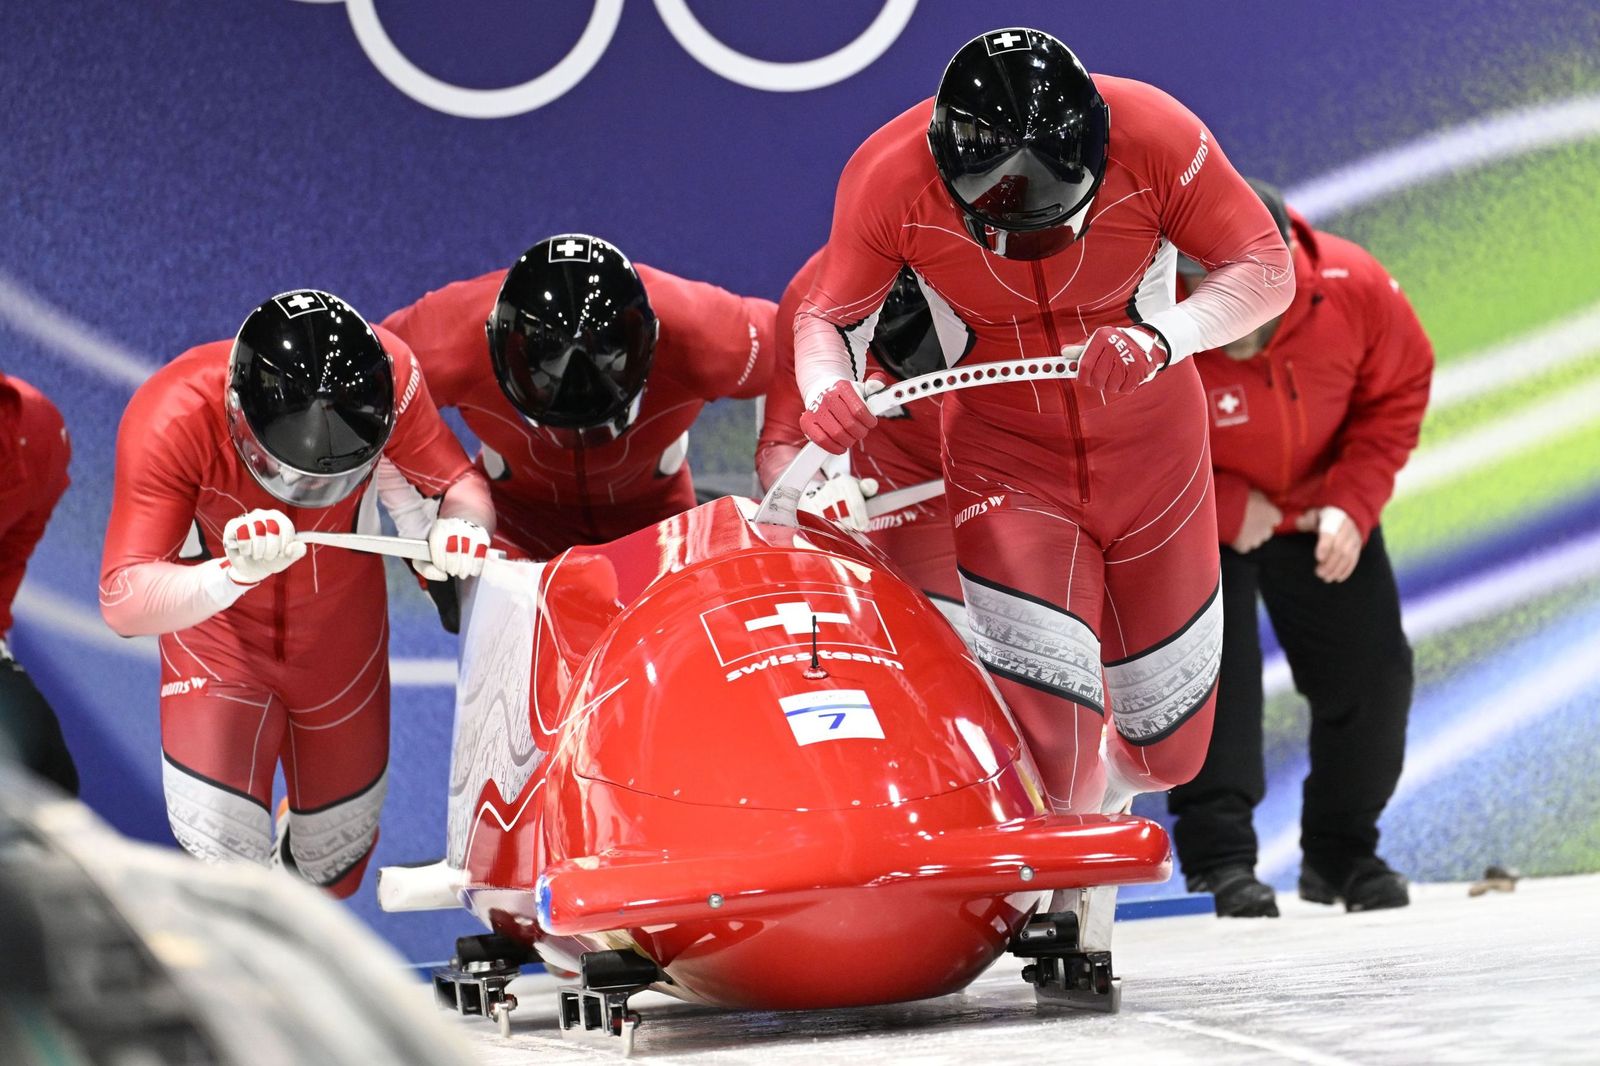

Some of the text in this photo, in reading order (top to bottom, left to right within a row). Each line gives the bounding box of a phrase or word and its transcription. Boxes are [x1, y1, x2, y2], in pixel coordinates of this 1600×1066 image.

[1108, 334, 1136, 366] SEIZ
[726, 649, 905, 682] swiss team
[818, 712, 847, 730] 7
